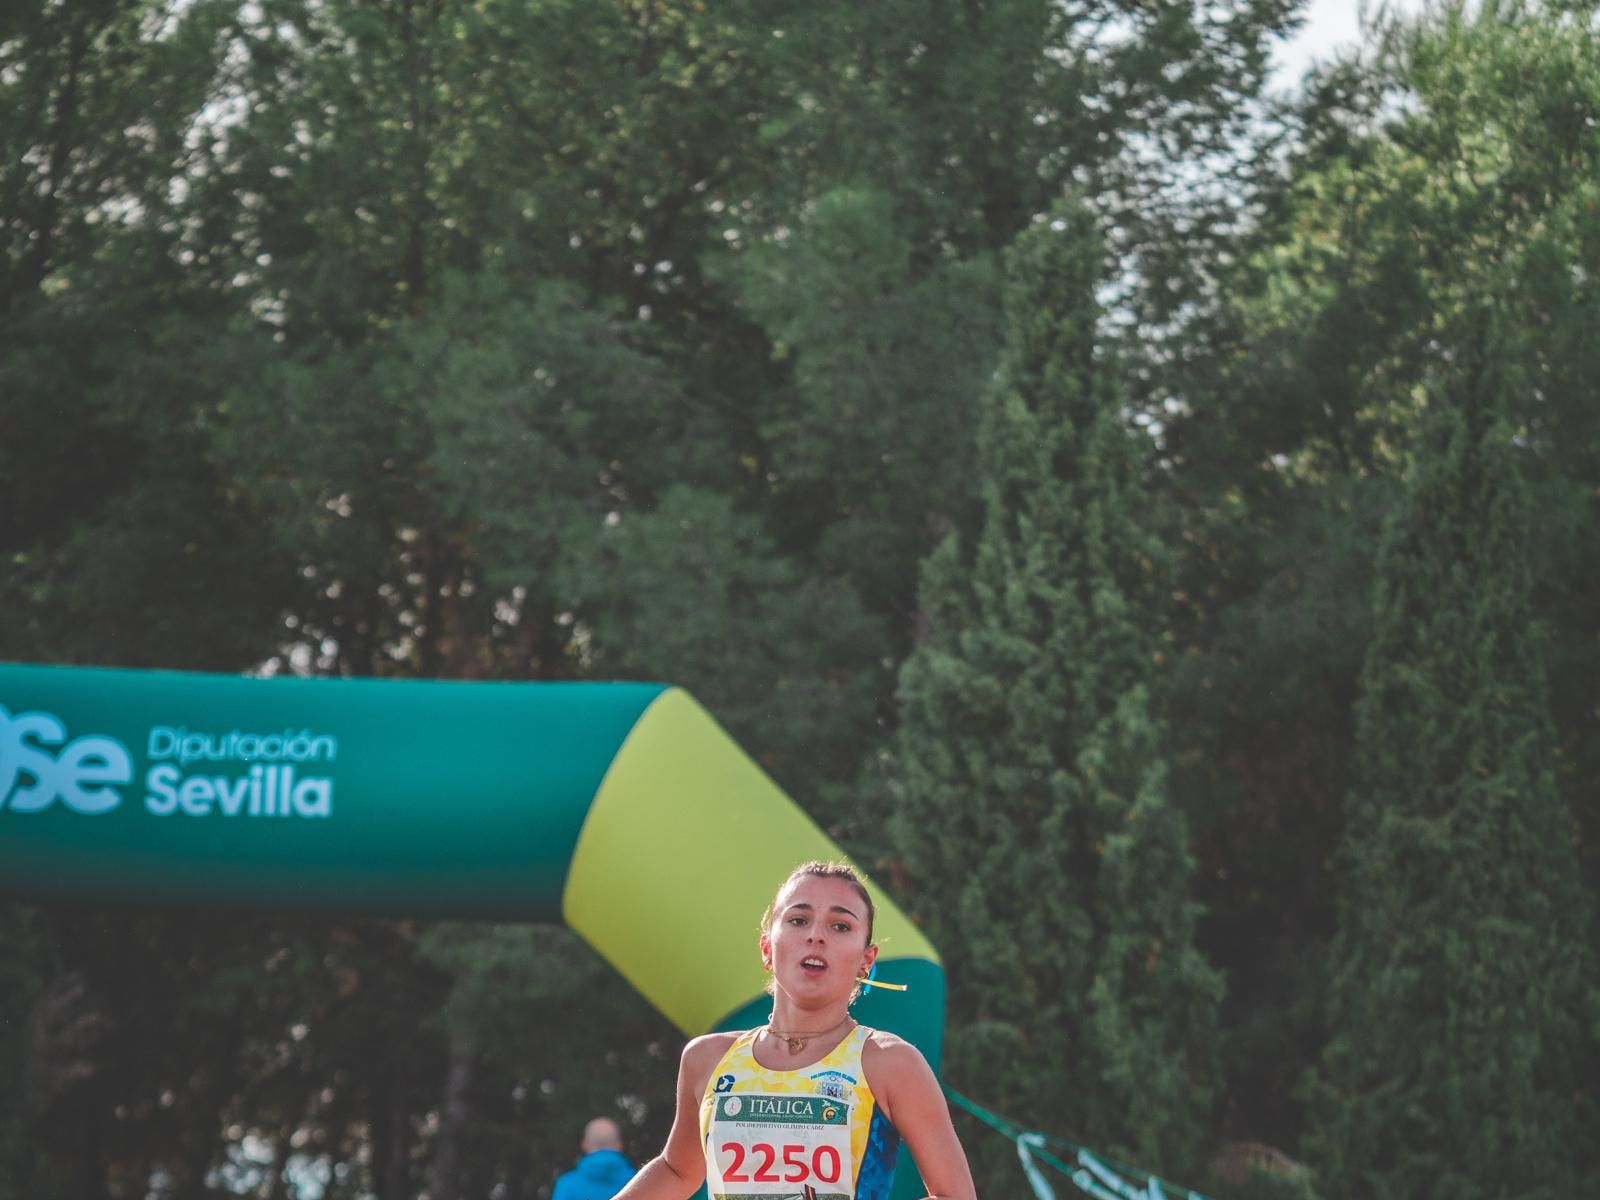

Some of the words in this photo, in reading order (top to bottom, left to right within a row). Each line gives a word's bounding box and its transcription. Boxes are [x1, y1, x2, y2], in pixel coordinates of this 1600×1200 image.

[147, 725, 337, 763] Diputación
[145, 762, 333, 817] Sevilla
[750, 1097, 814, 1115] ITÁLICA
[721, 1142, 841, 1183] 2250
